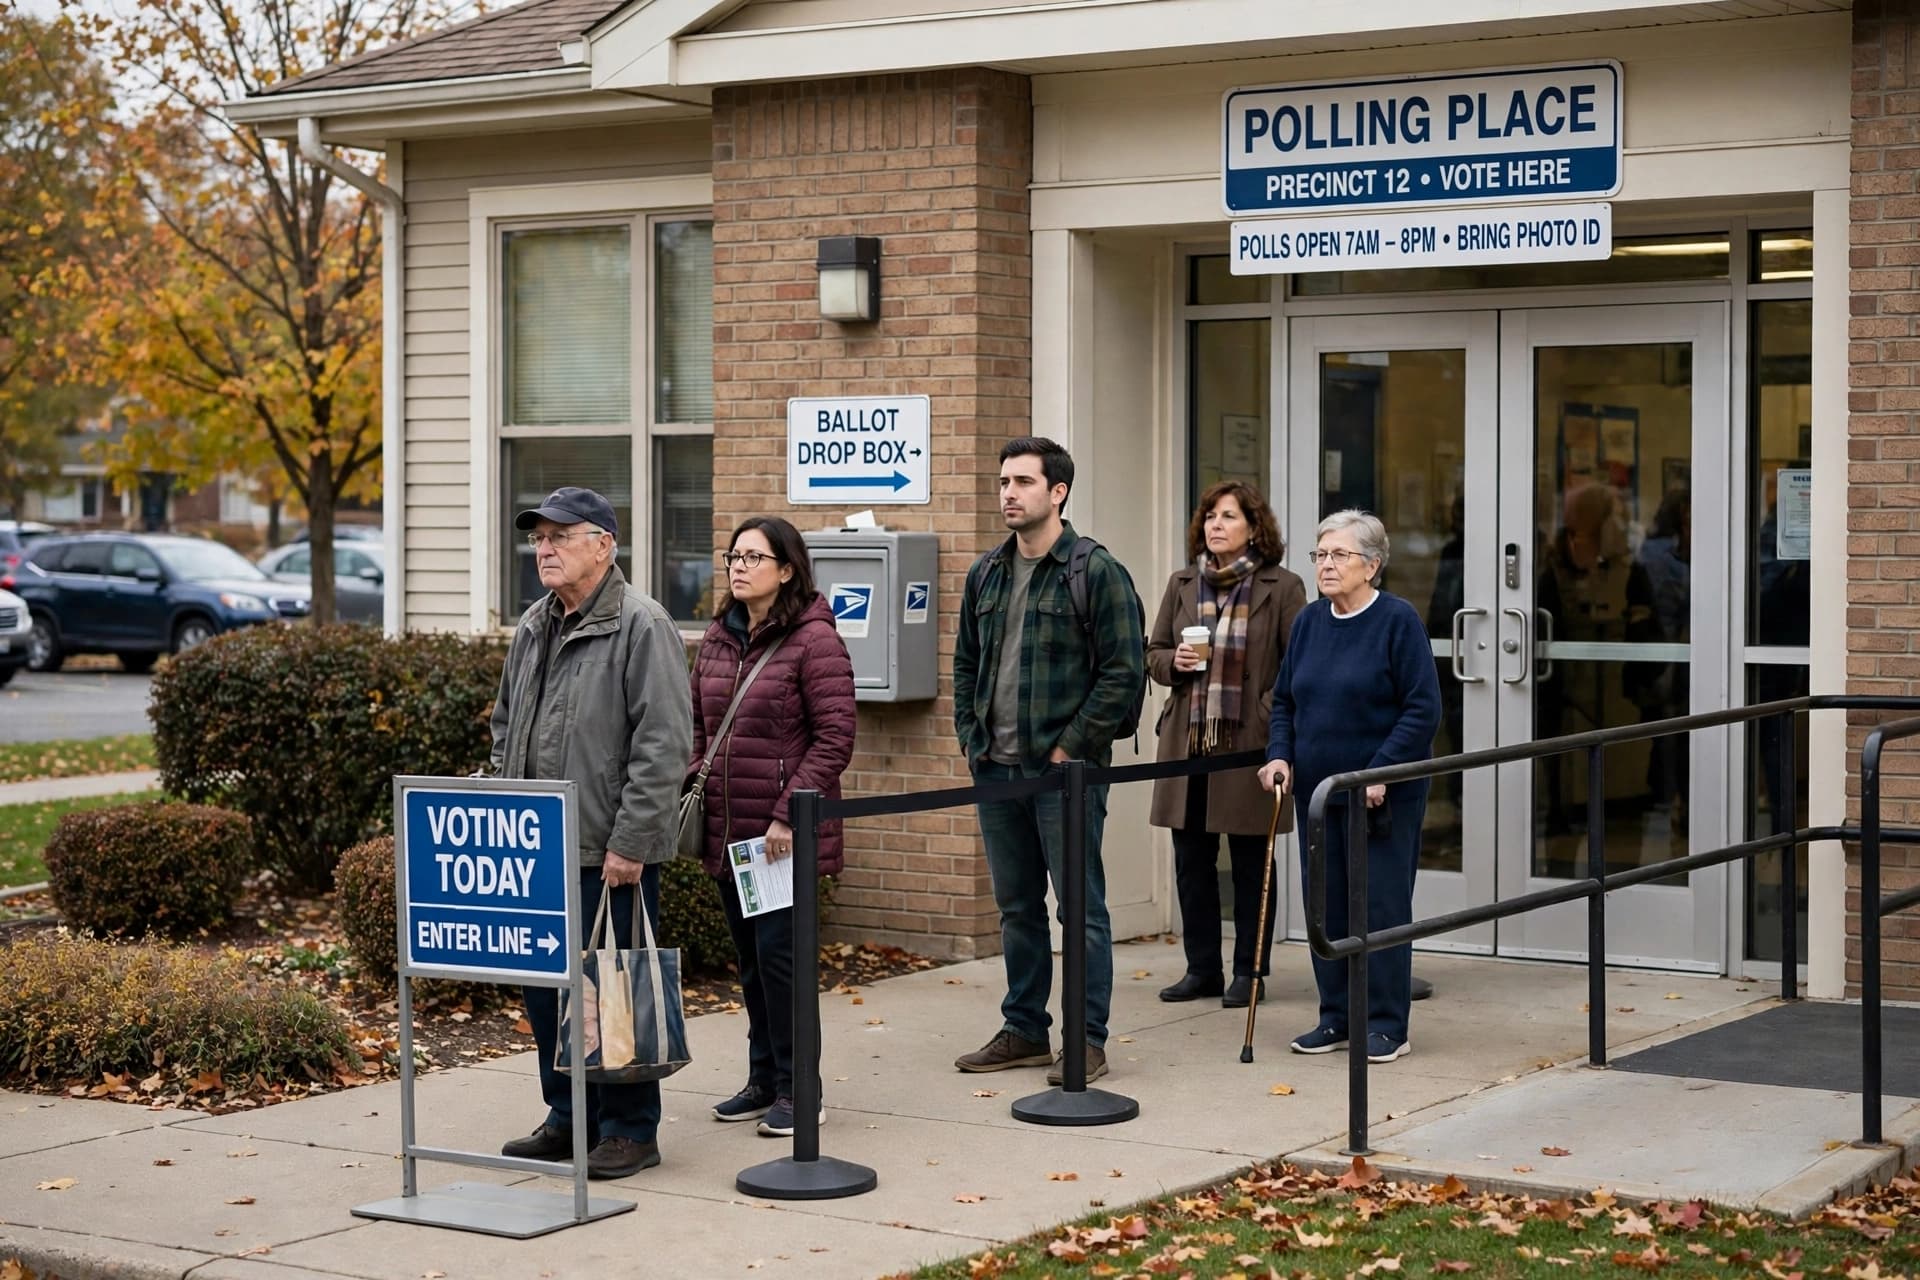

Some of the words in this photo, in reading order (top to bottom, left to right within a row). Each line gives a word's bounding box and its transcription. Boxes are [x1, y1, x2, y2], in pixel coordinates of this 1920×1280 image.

[1244, 95, 1431, 154] POLLING
[1447, 82, 1597, 141] PLACE
[1266, 168, 1377, 201] PRECINCT
[1384, 168, 1410, 194] 12
[1439, 161, 1501, 191] VOTE
[1508, 157, 1571, 188] HERE
[1239, 233, 1291, 261] POLLS
[1295, 230, 1341, 258] OPEN
[1345, 229, 1380, 256] 7AM
[1400, 226, 1436, 254] 8PM
[1457, 222, 1511, 251] BRING
[1516, 218, 1578, 248] PHOTO
[1583, 218, 1601, 246] ID
[817, 408, 900, 433] BALLOT
[798, 441, 857, 465] DROP
[863, 440, 907, 465] BOX
[426, 805, 541, 850] VOTING
[435, 853, 536, 898] TODAY
[417, 921, 482, 952] ENTER
[487, 925, 533, 956] LINE
